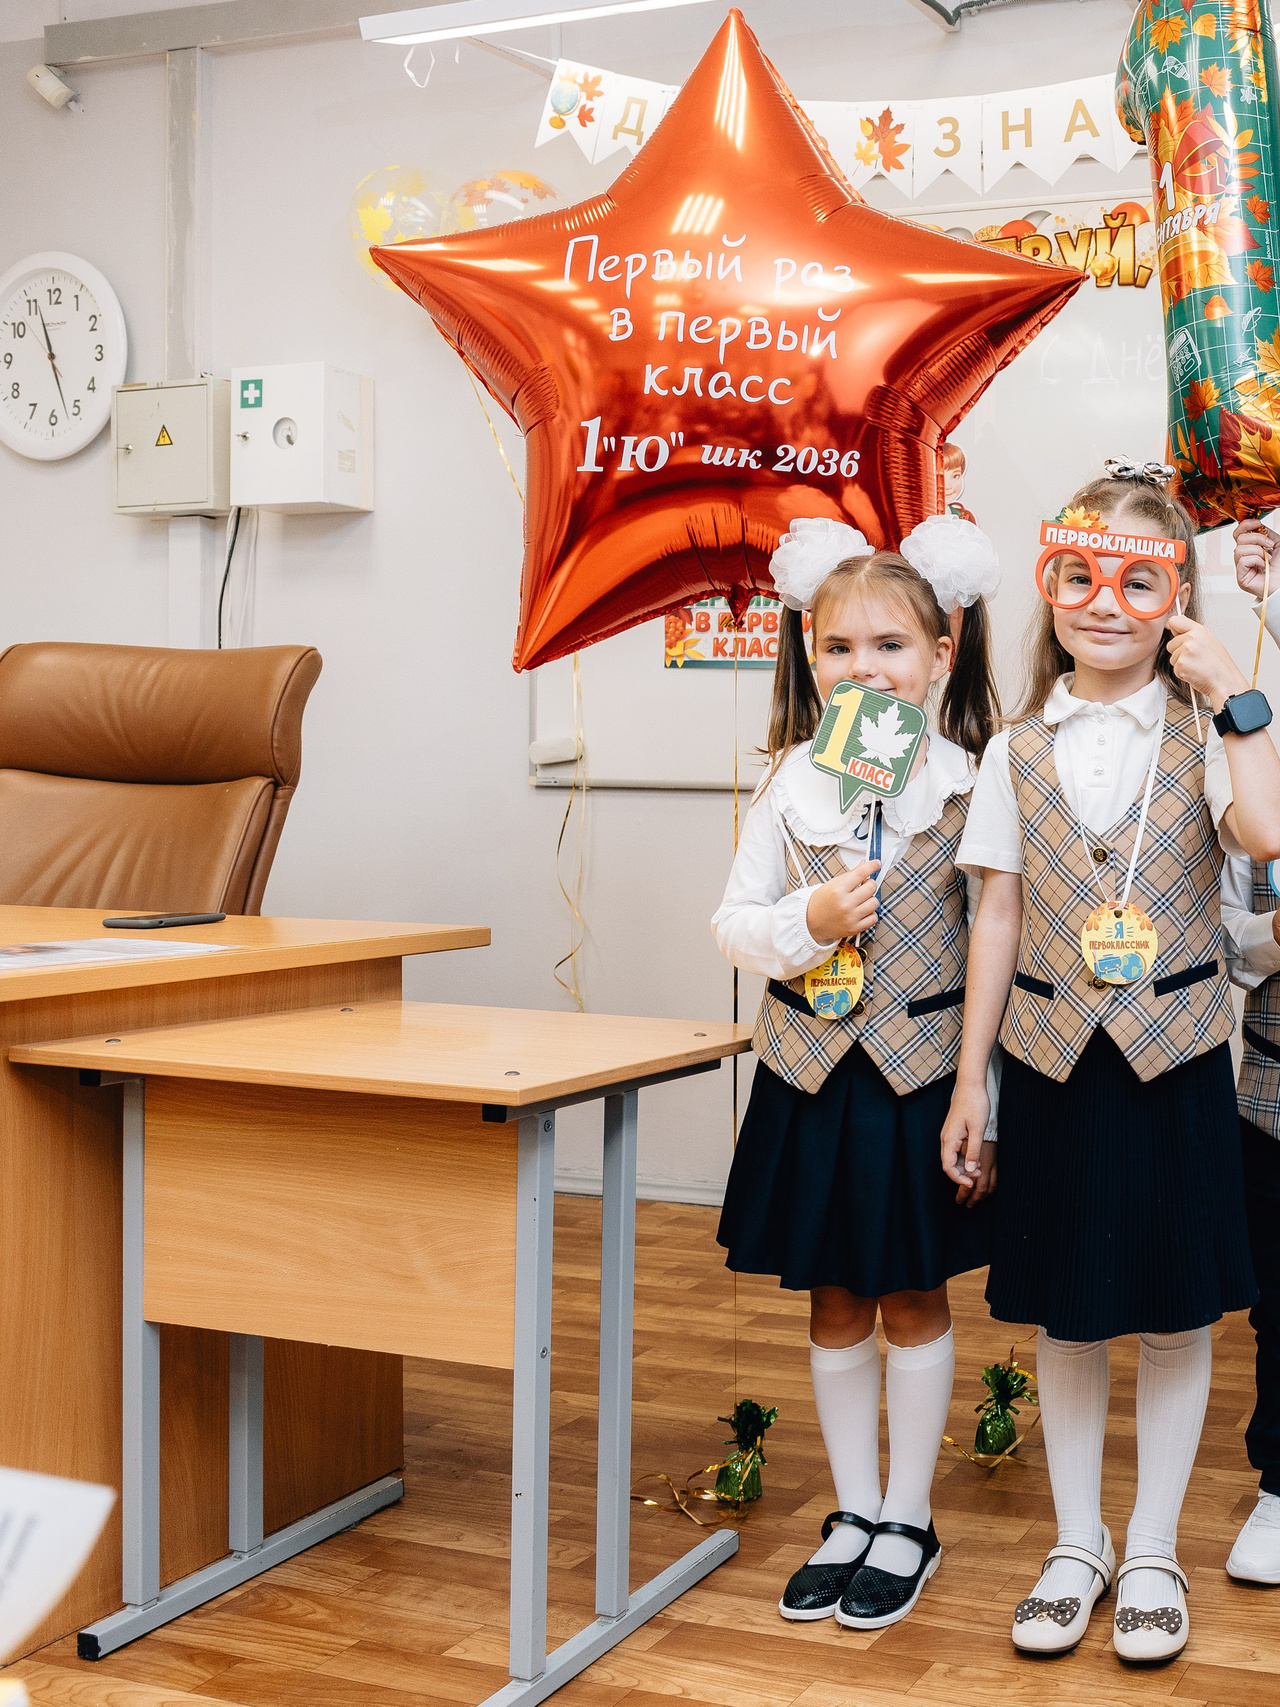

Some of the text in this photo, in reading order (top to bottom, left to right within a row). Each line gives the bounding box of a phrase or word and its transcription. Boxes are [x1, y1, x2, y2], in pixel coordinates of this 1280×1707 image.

[1158, 161, 1176, 212] 1
[563, 233, 855, 301] Первый раз
[46, 287, 62, 306] 12
[73, 294, 80, 312] 1
[26, 298, 38, 317] 11
[11, 321, 26, 339] 10
[88, 314, 98, 332] 2
[657, 306, 842, 365] первый
[3, 352, 13, 370] 9
[94, 344, 104, 362] 3
[11, 382, 20, 399] 8
[87, 376, 96, 394] 4
[643, 363, 795, 406] класс
[28, 402, 38, 420] 7
[48, 408, 58, 427] 6
[72, 399, 81, 417] 5
[700, 443, 763, 470] шк
[771, 444, 861, 478] 2036
[1045, 526, 1176, 559] ПЕРВОКЛАШКА
[695, 611, 711, 633] В
[712, 637, 779, 658] КЛАС
[813, 687, 865, 774] 1
[848, 758, 893, 789] КЛАСС
[1114, 920, 1124, 939] Я
[1089, 940, 1150, 950] ПЕРВОКЛАССНИК
[830, 959, 839, 977] Я
[810, 976, 858, 988] ПЕРВОКЛАССНИК
